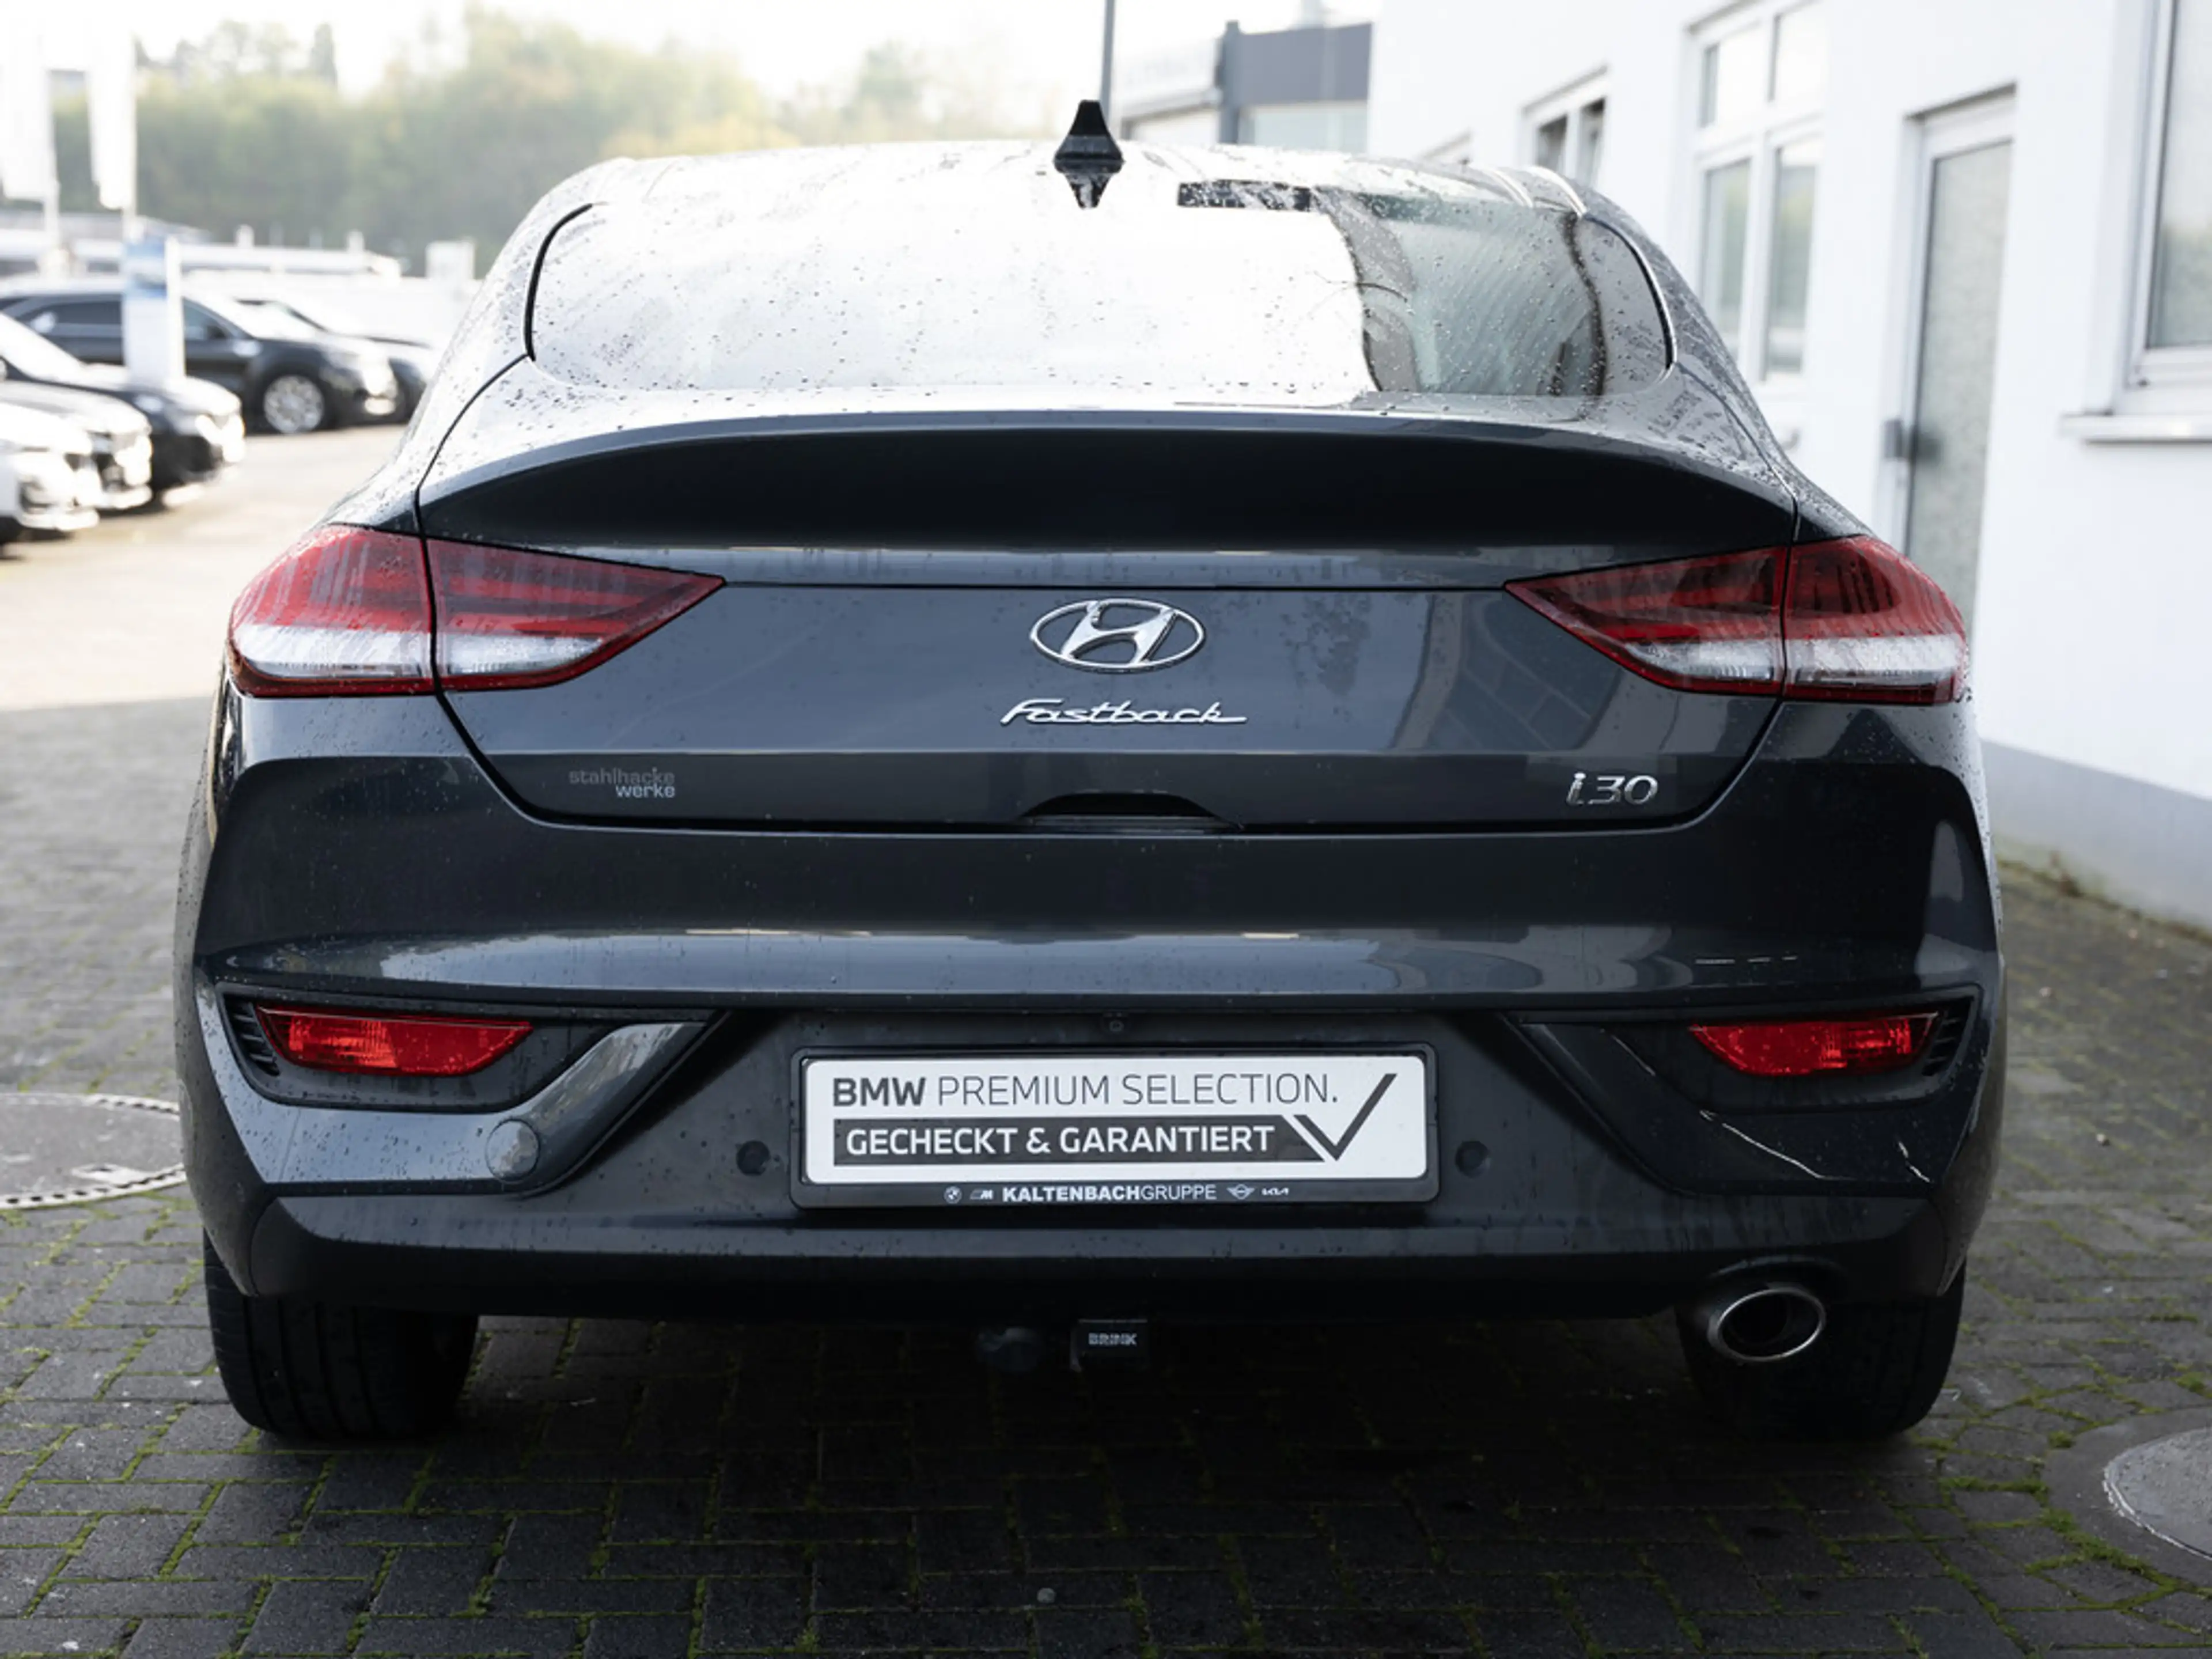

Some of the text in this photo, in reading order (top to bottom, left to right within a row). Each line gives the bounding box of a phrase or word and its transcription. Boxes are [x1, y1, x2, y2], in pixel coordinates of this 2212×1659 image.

[1001, 698, 1248, 725] Fastback
[569, 767, 675, 786] stahlhacke
[1566, 772, 1658, 805] i30
[615, 783, 676, 798] werke
[833, 1073, 1338, 1107] BMW PREMIUM SELECTION.
[846, 1124, 1275, 1155] GECHECKT & GARANTIERT
[1002, 1184, 1217, 1203] KALTENBACHGRUPPE
